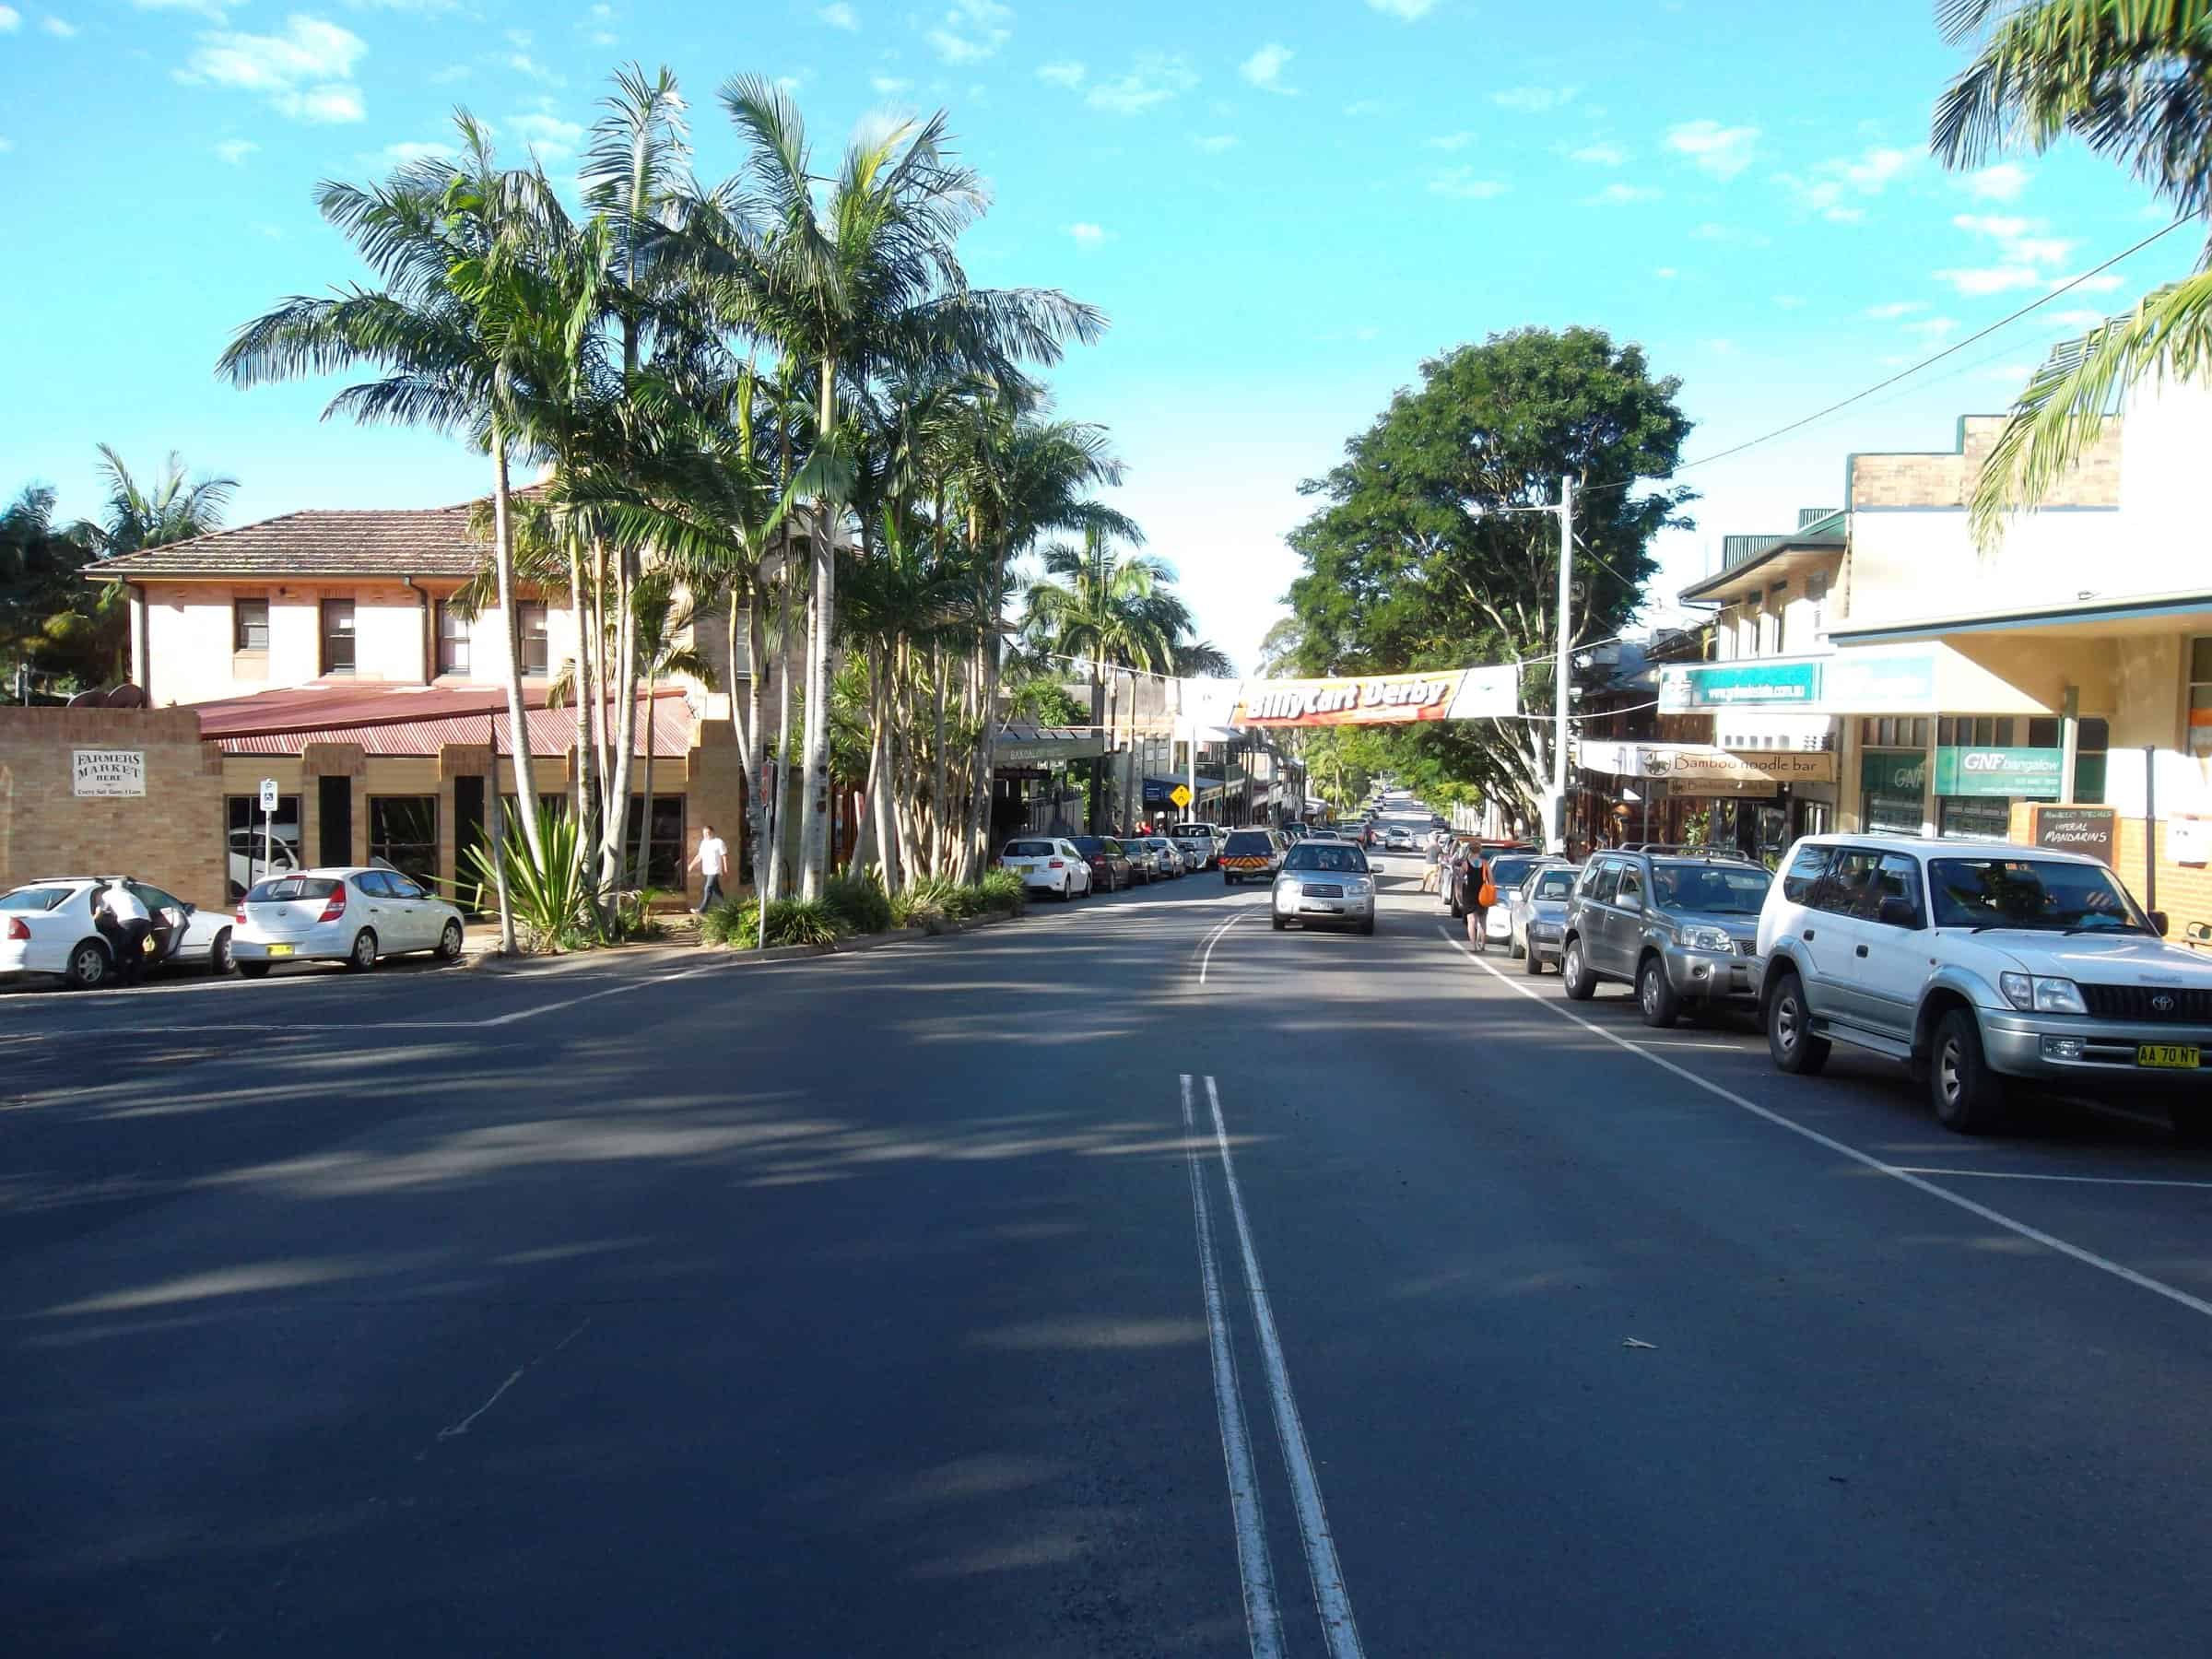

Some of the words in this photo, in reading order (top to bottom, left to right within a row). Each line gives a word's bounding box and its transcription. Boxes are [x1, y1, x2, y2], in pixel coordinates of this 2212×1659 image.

[1363, 679, 1450, 708] Derby
[77, 754, 140, 765] FARMERS
[1674, 756, 1737, 771] Bamboo
[1740, 757, 1791, 771] noodle
[1793, 757, 1818, 771] bar
[1964, 752, 2006, 771] GNF
[78, 764, 141, 780] MARKET
[2044, 830, 2108, 842] MANDARINS
[2139, 1047, 2156, 1062] AA
[2160, 1047, 2176, 1063] 70
[2180, 1048, 2198, 1063] NT
